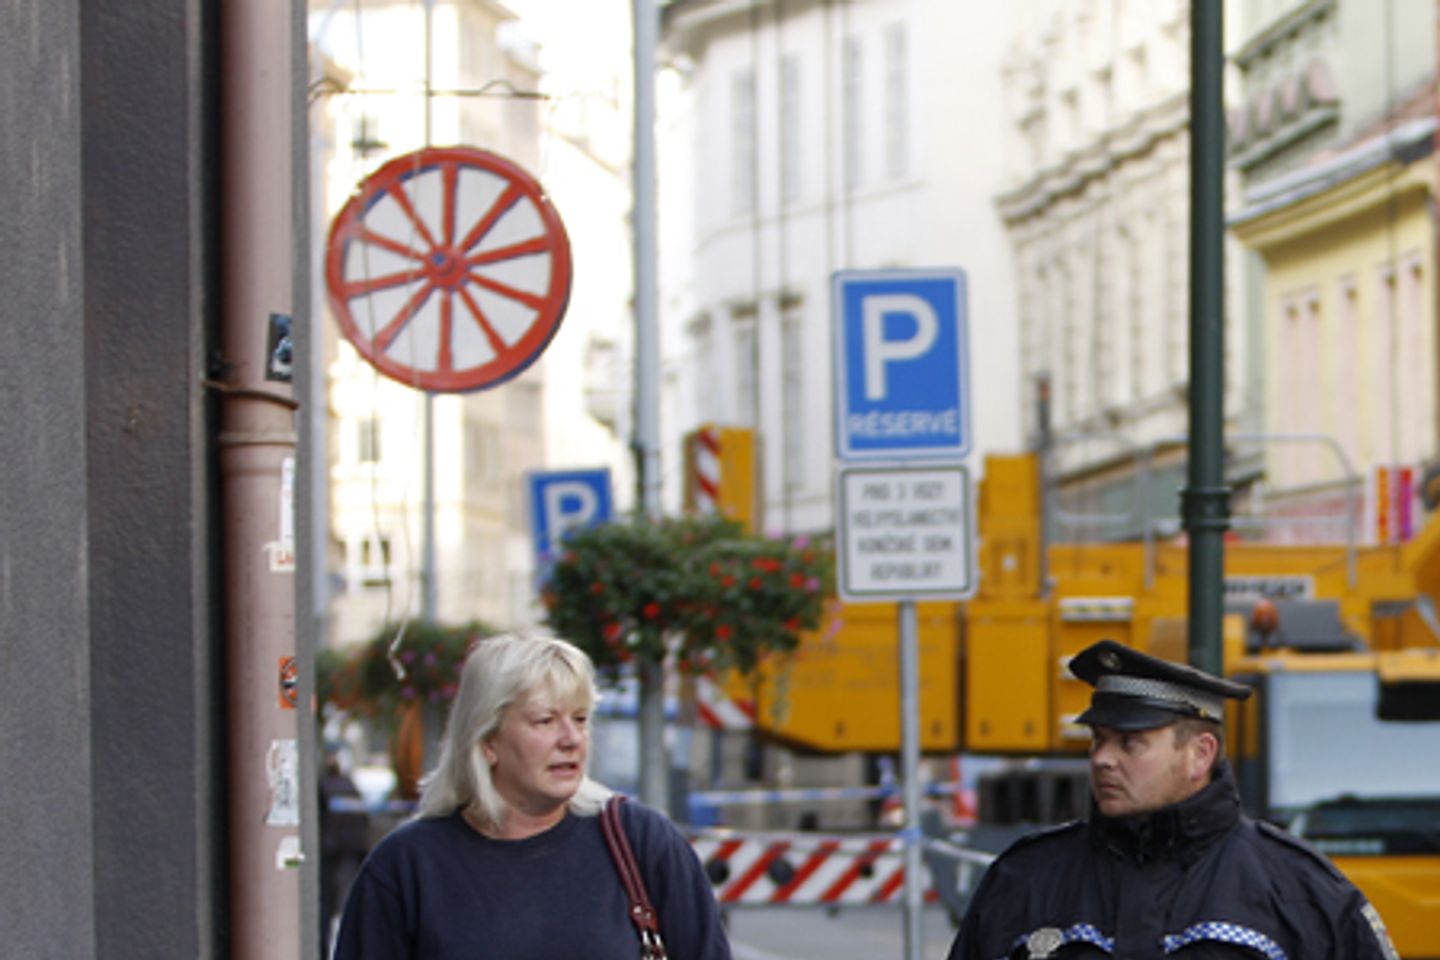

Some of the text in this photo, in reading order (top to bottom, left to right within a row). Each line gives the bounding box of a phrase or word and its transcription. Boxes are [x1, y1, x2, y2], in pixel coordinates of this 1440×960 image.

[861, 293, 940, 400] P
[846, 408, 959, 438] RÉSERVÉ
[545, 482, 598, 552] P
